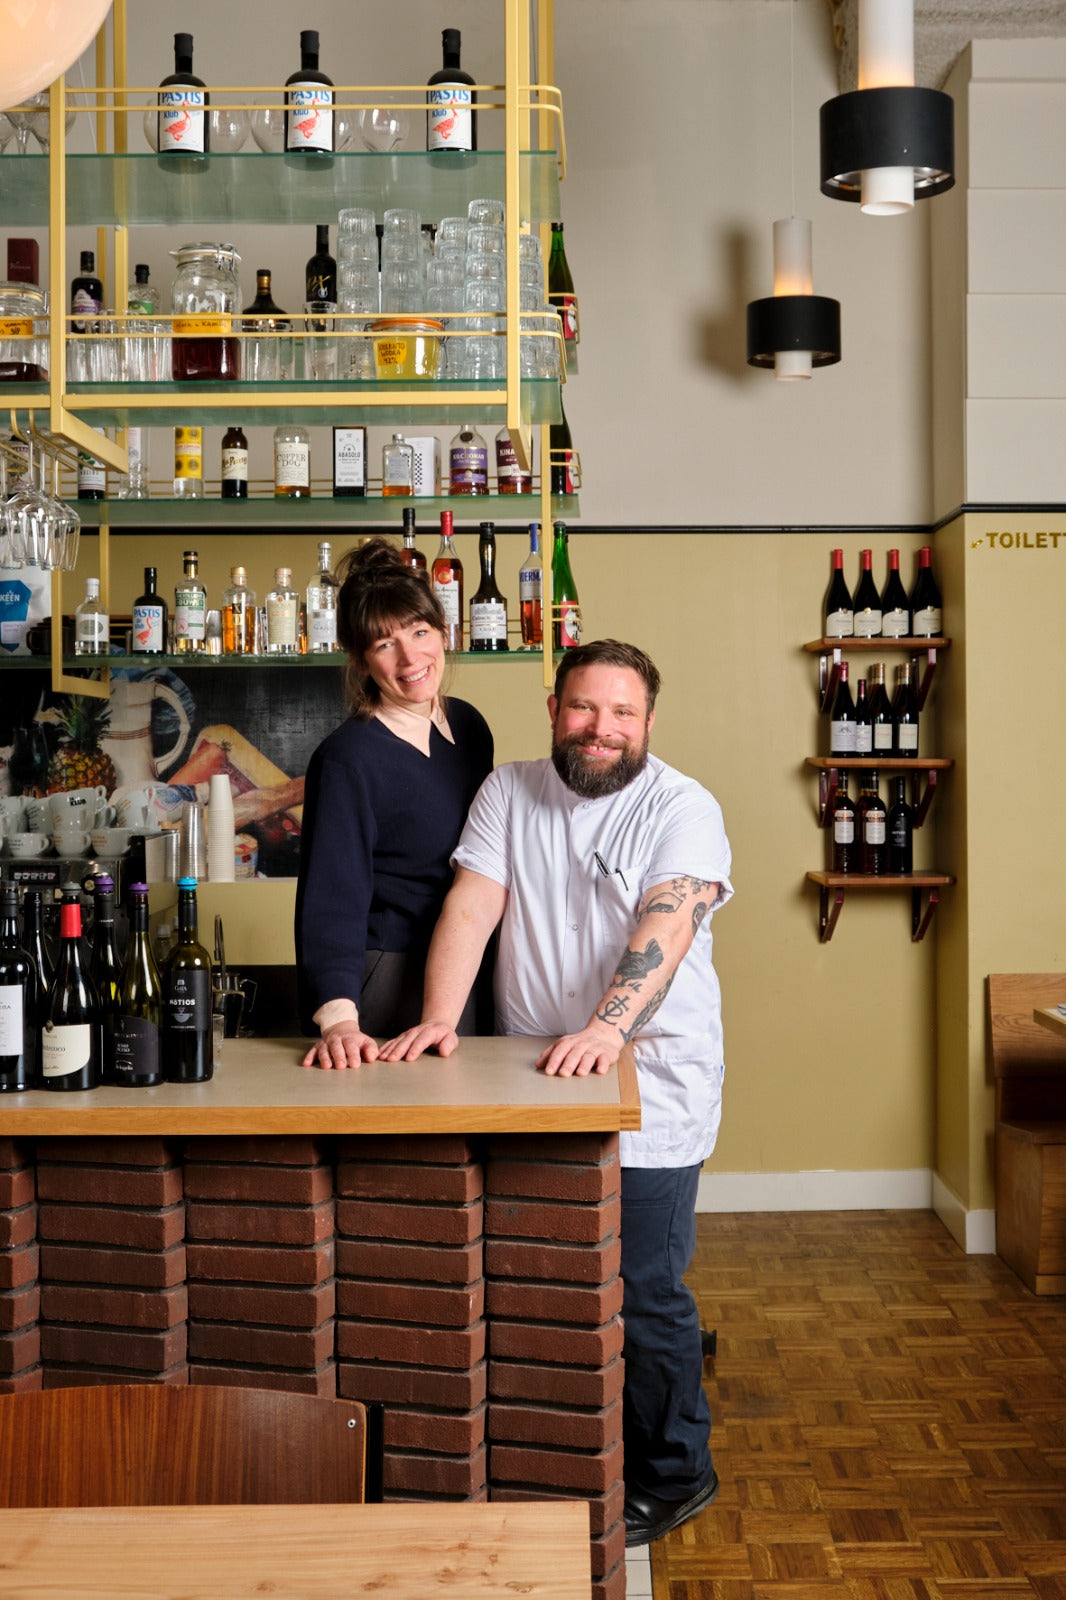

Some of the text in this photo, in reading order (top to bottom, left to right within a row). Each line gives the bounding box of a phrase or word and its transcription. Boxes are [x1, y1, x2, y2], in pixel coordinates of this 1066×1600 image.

[161, 91, 201, 104] PASTIS
[290, 90, 330, 102] PASTIS
[430, 89, 469, 101] PASTIS
[276, 452, 306, 462] COPPER
[133, 608, 161, 618] PASTIS
[70, 799, 87, 807] KLUB
